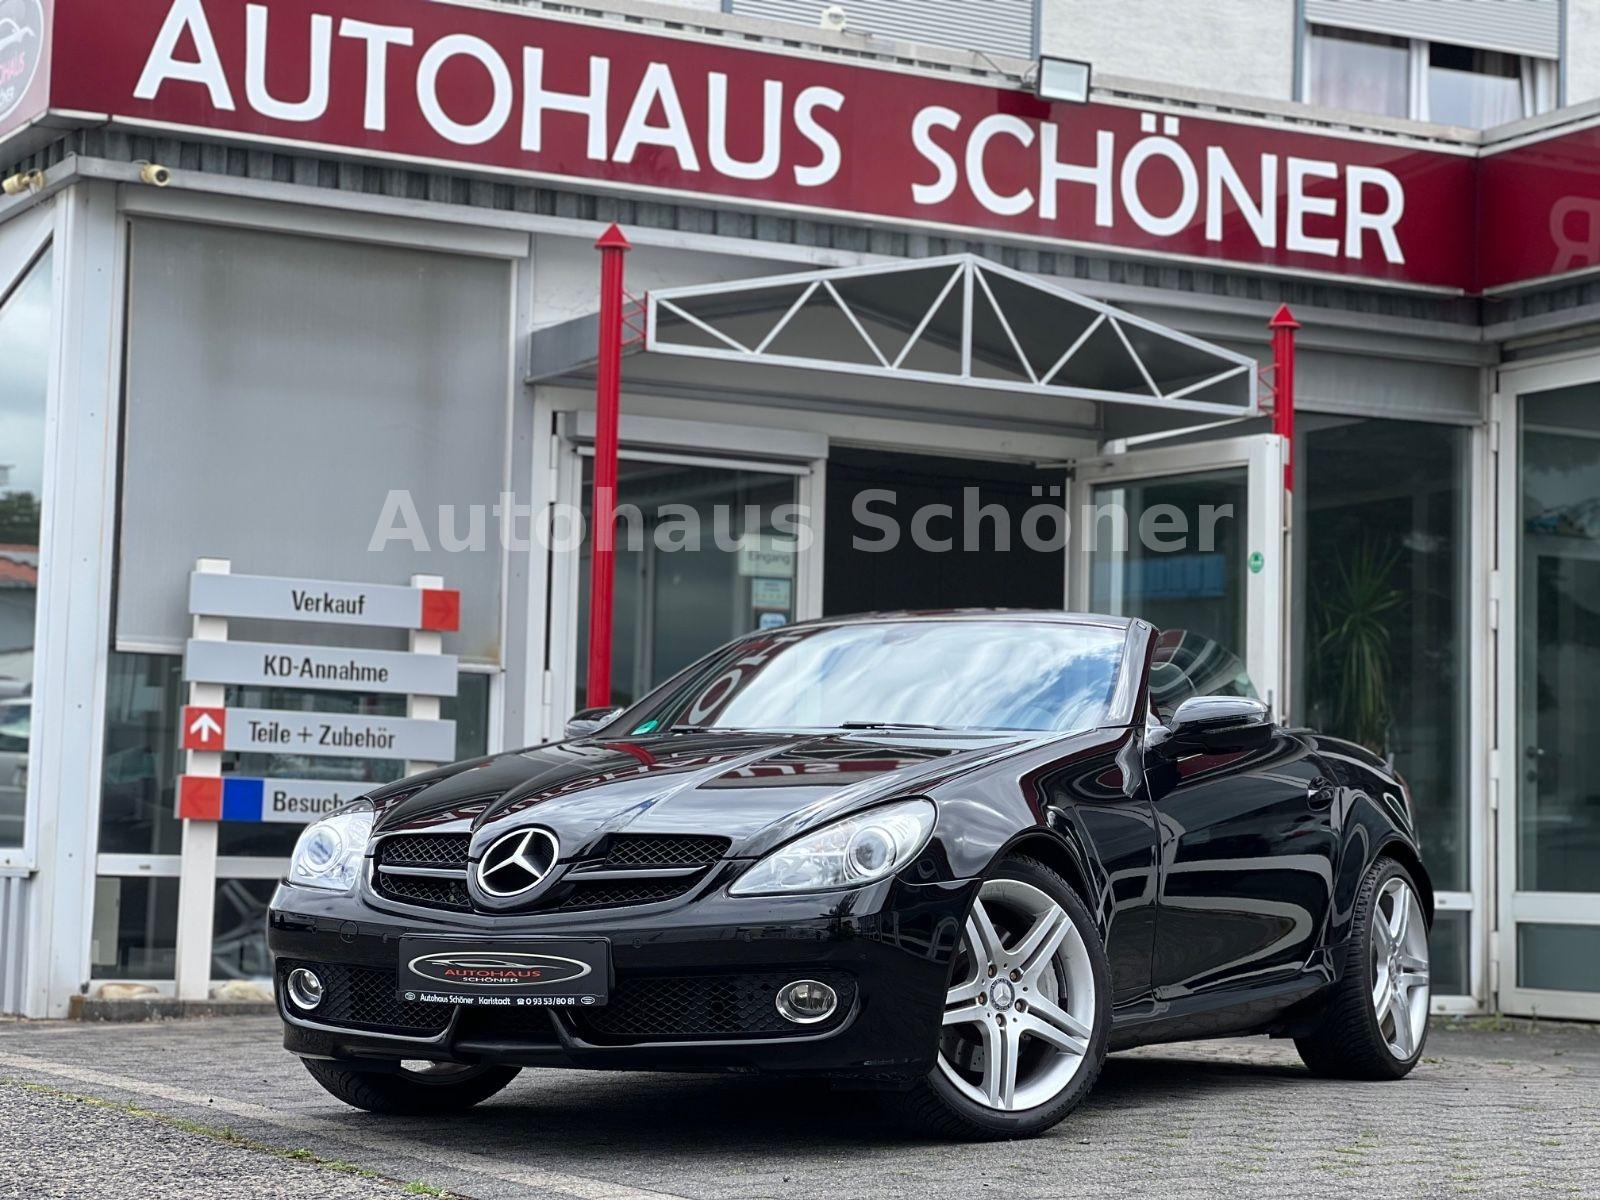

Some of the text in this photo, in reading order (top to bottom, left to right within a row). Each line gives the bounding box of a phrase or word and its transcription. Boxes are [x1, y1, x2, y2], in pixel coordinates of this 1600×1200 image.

[133, 0, 845, 187] AUTOHAUS
[911, 105, 1405, 264] SCHÖNER
[292, 590, 366, 615] Verkauf
[263, 654, 389, 682] KD-Annahme
[249, 721, 291, 743] Teile
[318, 725, 396, 749] Zubehör
[273, 791, 344, 813] Besuch
[444, 968, 542, 978] AUTOHAUS
[420, 993, 448, 1003] Autohaus
[449, 994, 474, 1004] Schöner
[478, 996, 511, 1005] Karlstadt
